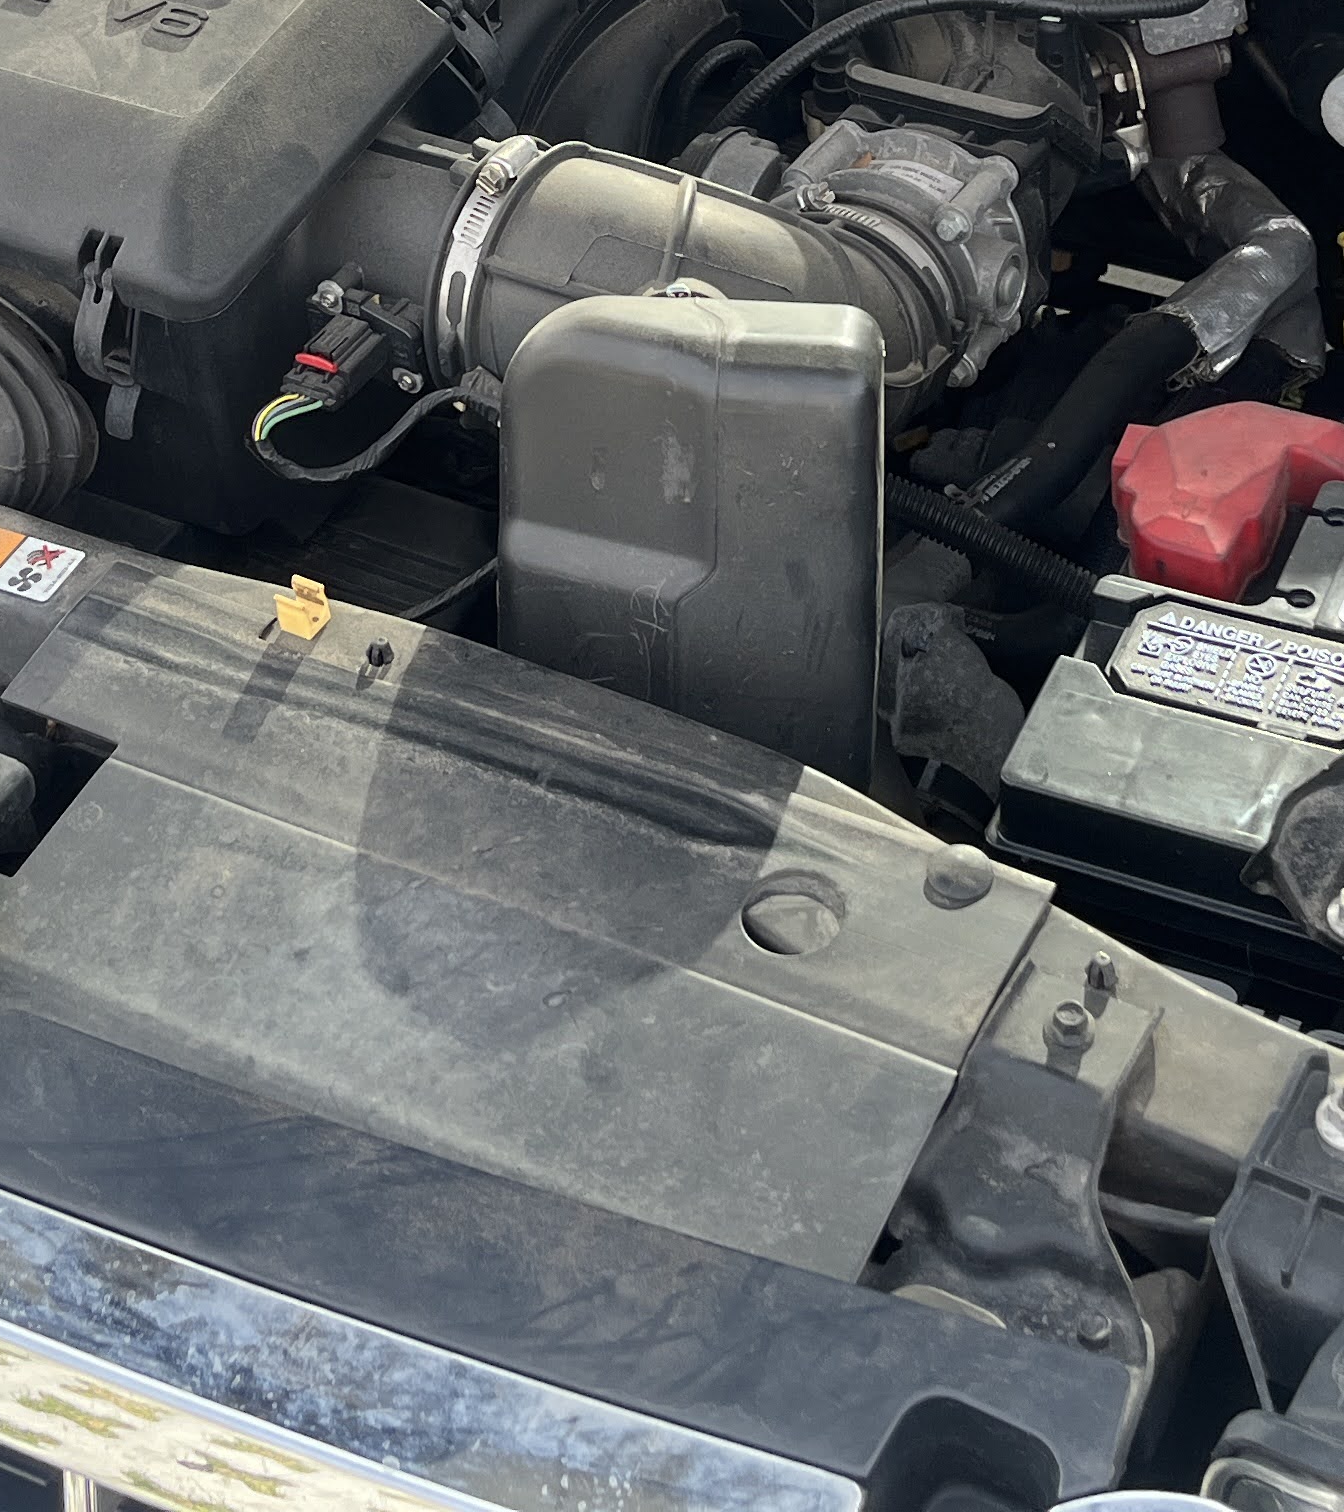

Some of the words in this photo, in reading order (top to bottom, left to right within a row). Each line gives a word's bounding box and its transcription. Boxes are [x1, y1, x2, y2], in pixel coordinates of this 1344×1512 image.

[1179, 615, 1263, 649] DANGER
[1192, 650, 1219, 663] EYES
[1196, 642, 1233, 658] SHIELD
[1243, 672, 1263, 685] NO
